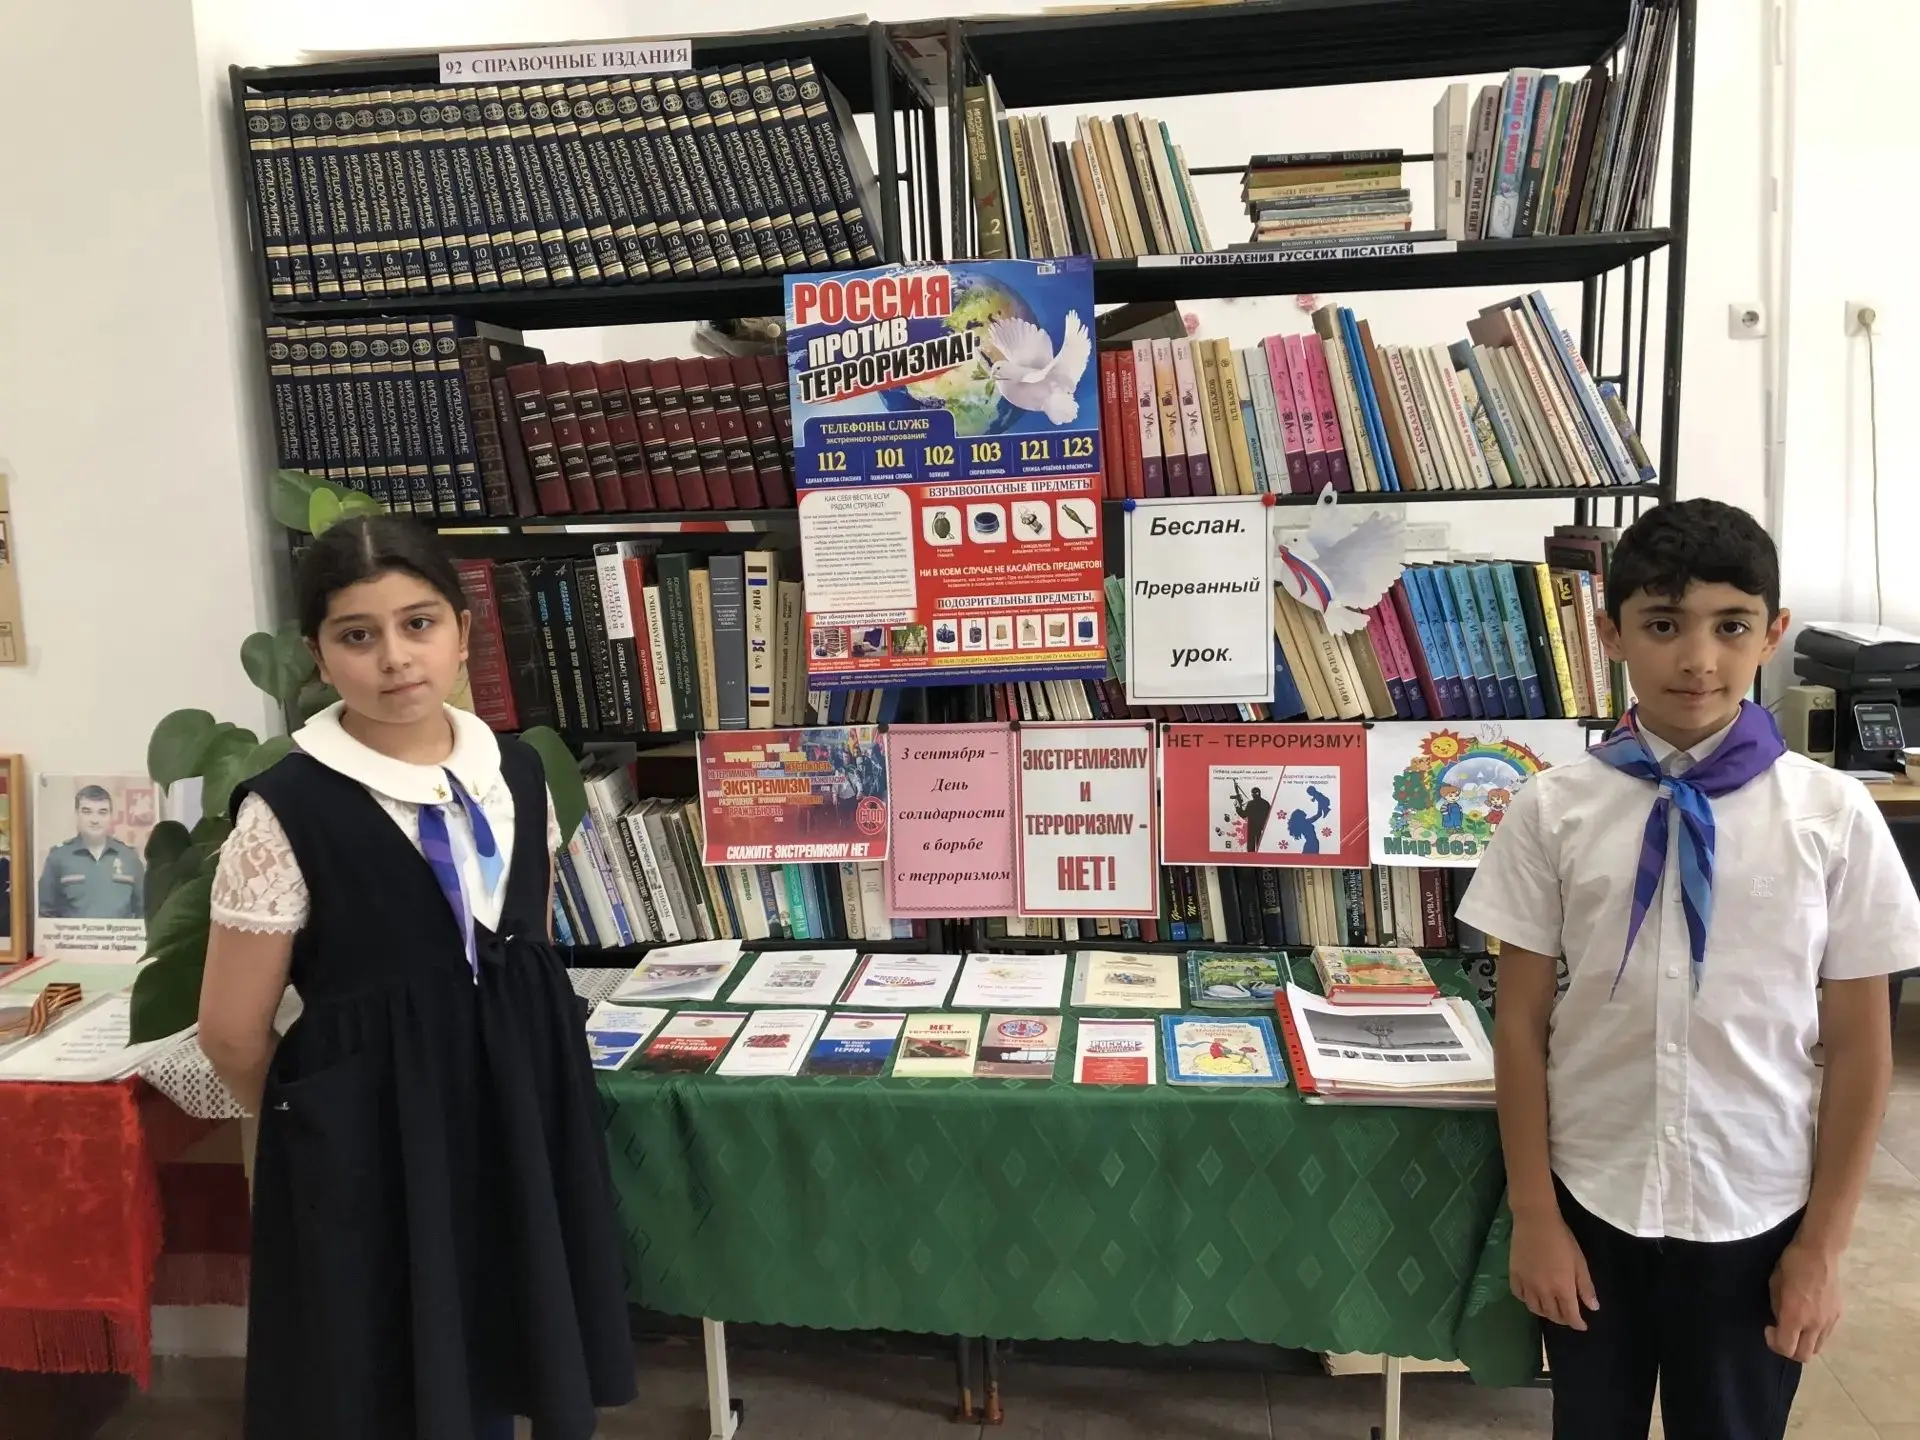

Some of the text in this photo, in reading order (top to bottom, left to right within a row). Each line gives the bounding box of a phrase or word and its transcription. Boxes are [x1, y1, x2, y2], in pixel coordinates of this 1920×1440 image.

[446, 48, 688, 74] 92 СПРАВОЧНЫЕ ИЗДАНИЯ
[803, 228, 816, 239] 24
[850, 223, 863, 235] 26
[990, 218, 1001, 234] 2
[622, 239, 636, 250] 16
[667, 236, 680, 246] 18
[713, 234, 727, 245] 20
[759, 232, 772, 242] 22
[474, 248, 487, 259] 10
[522, 245, 534, 256] 12
[574, 243, 587, 253] 14
[1180, 244, 1414, 266] ПРОИЗВЕДЕНИЯ РУССКИХ ПИСАТЕЛЕЙ
[794, 274, 951, 325] РОССИЯ
[808, 318, 908, 366] ПРОТИВ
[799, 331, 973, 403] ТЕРРОРИЗМА!
[1392, 354, 1426, 454] РАССКАЗЫ ДЛЯ ДЕТЕЙ
[820, 418, 929, 435] ТЕЛЕФОНЫ СЛУЖБ
[826, 433, 927, 444] экстренного реагирования:
[1062, 437, 1094, 457] 123
[876, 448, 905, 468] 101
[924, 446, 955, 466] 102
[970, 443, 1002, 463] 103
[1020, 440, 1050, 460] 121
[818, 451, 846, 471] 112
[929, 478, 1093, 498] ВЗРЫВООПАСНЫЕ ПРЕДМЕТЫ
[1149, 516, 1246, 536] Беслан.
[920, 569, 931, 577] НИ
[933, 568, 938, 576] В
[940, 567, 961, 576] КОЕМ
[963, 566, 992, 575] СЛУЧАЕ
[1007, 562, 1051, 572] КАСАЙТЕСЬ
[1053, 561, 1102, 570] ПРЕДМЕТОВ!
[605, 566, 618, 629] ВОПРОСОВ
[1135, 578, 1260, 599] Прерванный
[752, 590, 762, 610] 2018
[938, 592, 1095, 608] ПОДОЗРИТЕЛЬНЫЕ ПРЕДМЕТЫ,
[649, 594, 666, 684] ВЕСЁЛАЯ ГРАММАТИКА
[617, 643, 627, 676] ПОЧЕМУ?
[1171, 647, 1233, 667] урок.
[600, 641, 614, 703] БРОКГАУЗ
[623, 680, 632, 706] ЗАЧЕМ?
[1167, 734, 1204, 748] НЕТ
[1224, 734, 1362, 749] ТЕРРОРИЗМУ!
[901, 748, 909, 760] 3
[914, 746, 986, 761] сентября
[1022, 748, 1147, 771] ЭКСТРЕМИЗМУ
[723, 778, 810, 795] ЭКСТРЕМИЗМ
[931, 779, 969, 792] День
[1080, 781, 1091, 802] И
[858, 811, 884, 823] СТОП
[898, 808, 1006, 821] солидарности
[1025, 814, 1134, 836] ТЕРРОРИЗМУ
[620, 821, 635, 857] ОСТРОВОВ
[923, 839, 984, 853] в борьбе
[1384, 837, 1431, 857] Мир
[1437, 837, 1477, 855] без
[727, 843, 869, 859] СКАЖИТЕ ЭКСТРЕМИЗМУ НЕТ
[898, 870, 1011, 884] с терроризмом
[1058, 856, 1116, 891] НЕТ!
[1349, 871, 1357, 902] НЕНАВИС
[644, 900, 659, 933] ЗАГАДКИ
[1425, 891, 1435, 926] ВАРВАР
